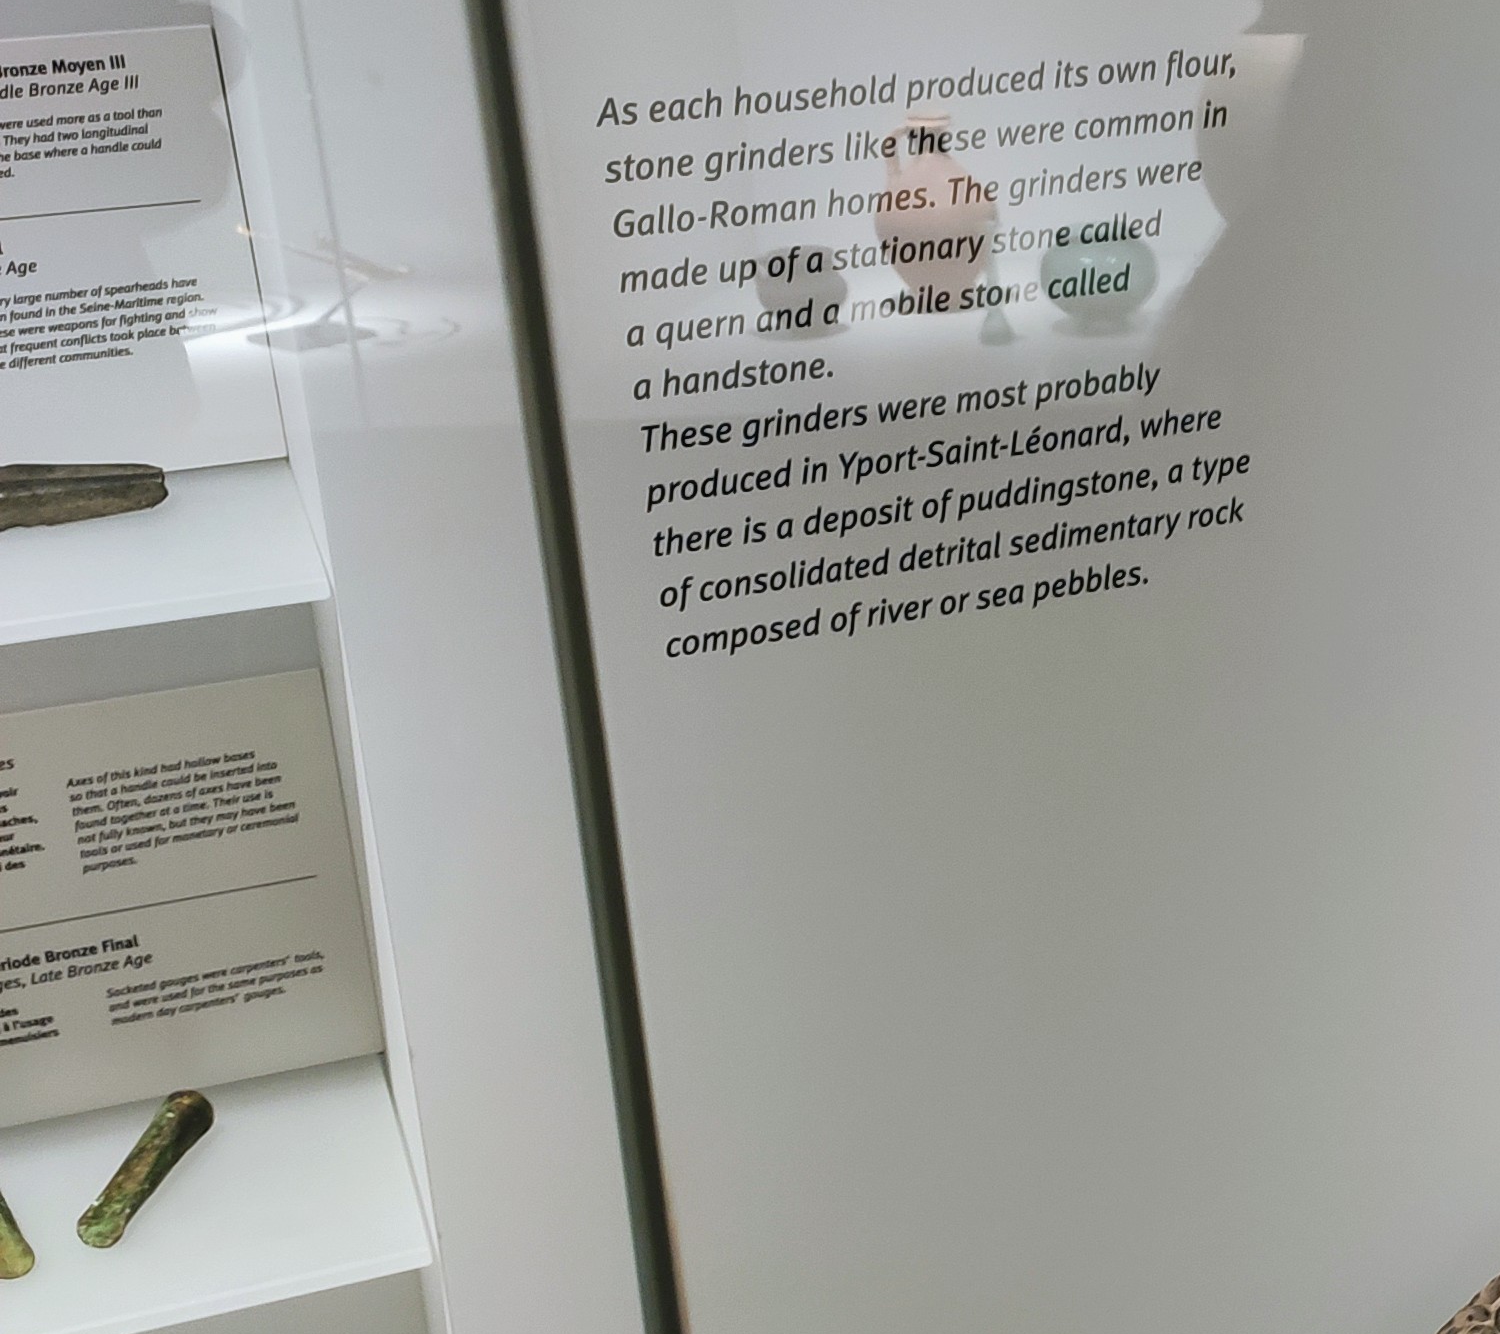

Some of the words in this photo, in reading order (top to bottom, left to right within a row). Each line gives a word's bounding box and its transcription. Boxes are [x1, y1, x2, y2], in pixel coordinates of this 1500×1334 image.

[29, 81, 84, 97] Bronze
[88, 77, 119, 95] Age
[52, 58, 106, 75] Moyen
[596, 97, 638, 128] As
[648, 87, 723, 123] each
[734, 73, 897, 116] household
[906, 61, 1046, 109] produced
[1054, 60, 1089, 89] its
[1097, 59, 1157, 85] own
[1165, 49, 1236, 87] flour,
[3, 134, 31, 147] They
[33, 131, 55, 144] had
[58, 132, 79, 142] two
[82, 123, 149, 140] longitudinal
[26, 115, 54, 128] used
[56, 115, 85, 126] more
[88, 113, 101, 123] as
[103, 113, 111, 122] a
[113, 108, 135, 121] tool
[137, 107, 163, 119] than
[604, 154, 694, 184] stone
[704, 137, 834, 182] grinders
[844, 130, 897, 162] like
[907, 126, 987, 156] these
[997, 121, 1065, 148] were
[1074, 109, 1194, 141] common
[1203, 99, 1228, 129] in
[613, 198, 816, 238] Gallo-Roman
[827, 187, 936, 218] homes.
[947, 175, 999, 206] The
[1008, 164, 1127, 207] grinders
[1136, 160, 1203, 187] were
[620, 256, 708, 294] made
[719, 259, 758, 289] up
[767, 245, 801, 284] of
[806, 251, 824, 274] a
[832, 234, 985, 271] stationary
[991, 226, 1071, 254] stone
[1079, 208, 1162, 245] called
[10, 308, 43, 323] found
[45, 307, 56, 317] in
[58, 305, 77, 317] the
[79, 297, 164, 314] Seine-Maritime
[166, 292, 205, 306] region.
[13, 294, 42, 306] large
[45, 288, 89, 302] number
[90, 285, 102, 298] of
[104, 279, 169, 297] spearheads
[171, 278, 198, 289] have
[9, 354, 57, 369] different
[59, 347, 134, 363] communities.
[640, 421, 732, 453] These
[741, 402, 868, 448] grinders
[877, 395, 947, 424] were
[956, 380, 1028, 414] most
[1034, 362, 1161, 411] probably
[646, 458, 792, 513] produced
[801, 456, 828, 485] in
[838, 414, 1130, 486] Yport-Saint-Léonard,
[1140, 408, 1222, 440] where
[653, 526, 733, 557] there
[743, 516, 767, 545] is
[776, 518, 794, 540] a
[803, 495, 914, 538] deposit
[921, 487, 954, 524] of
[957, 468, 1159, 522] puddingstone,
[1167, 463, 1184, 485] a
[1192, 454, 1251, 487] type
[659, 575, 694, 613] of
[699, 547, 890, 602] consolidated
[898, 530, 1001, 573] detrital
[1008, 511, 1182, 557] sedimentary
[1187, 496, 1244, 530] rock
[666, 607, 821, 658] composed
[830, 601, 863, 637] of
[867, 597, 934, 628] river
[939, 591, 971, 616] or
[976, 584, 1025, 611] sea
[1032, 563, 1149, 609] pebbles.
[0, 954, 41, 971] riode
[45, 945, 98, 963] Bronze
[101, 934, 140, 953] Final
[31, 970, 63, 985] Late
[67, 959, 120, 978] Bronze
[123, 953, 154, 968] Age
